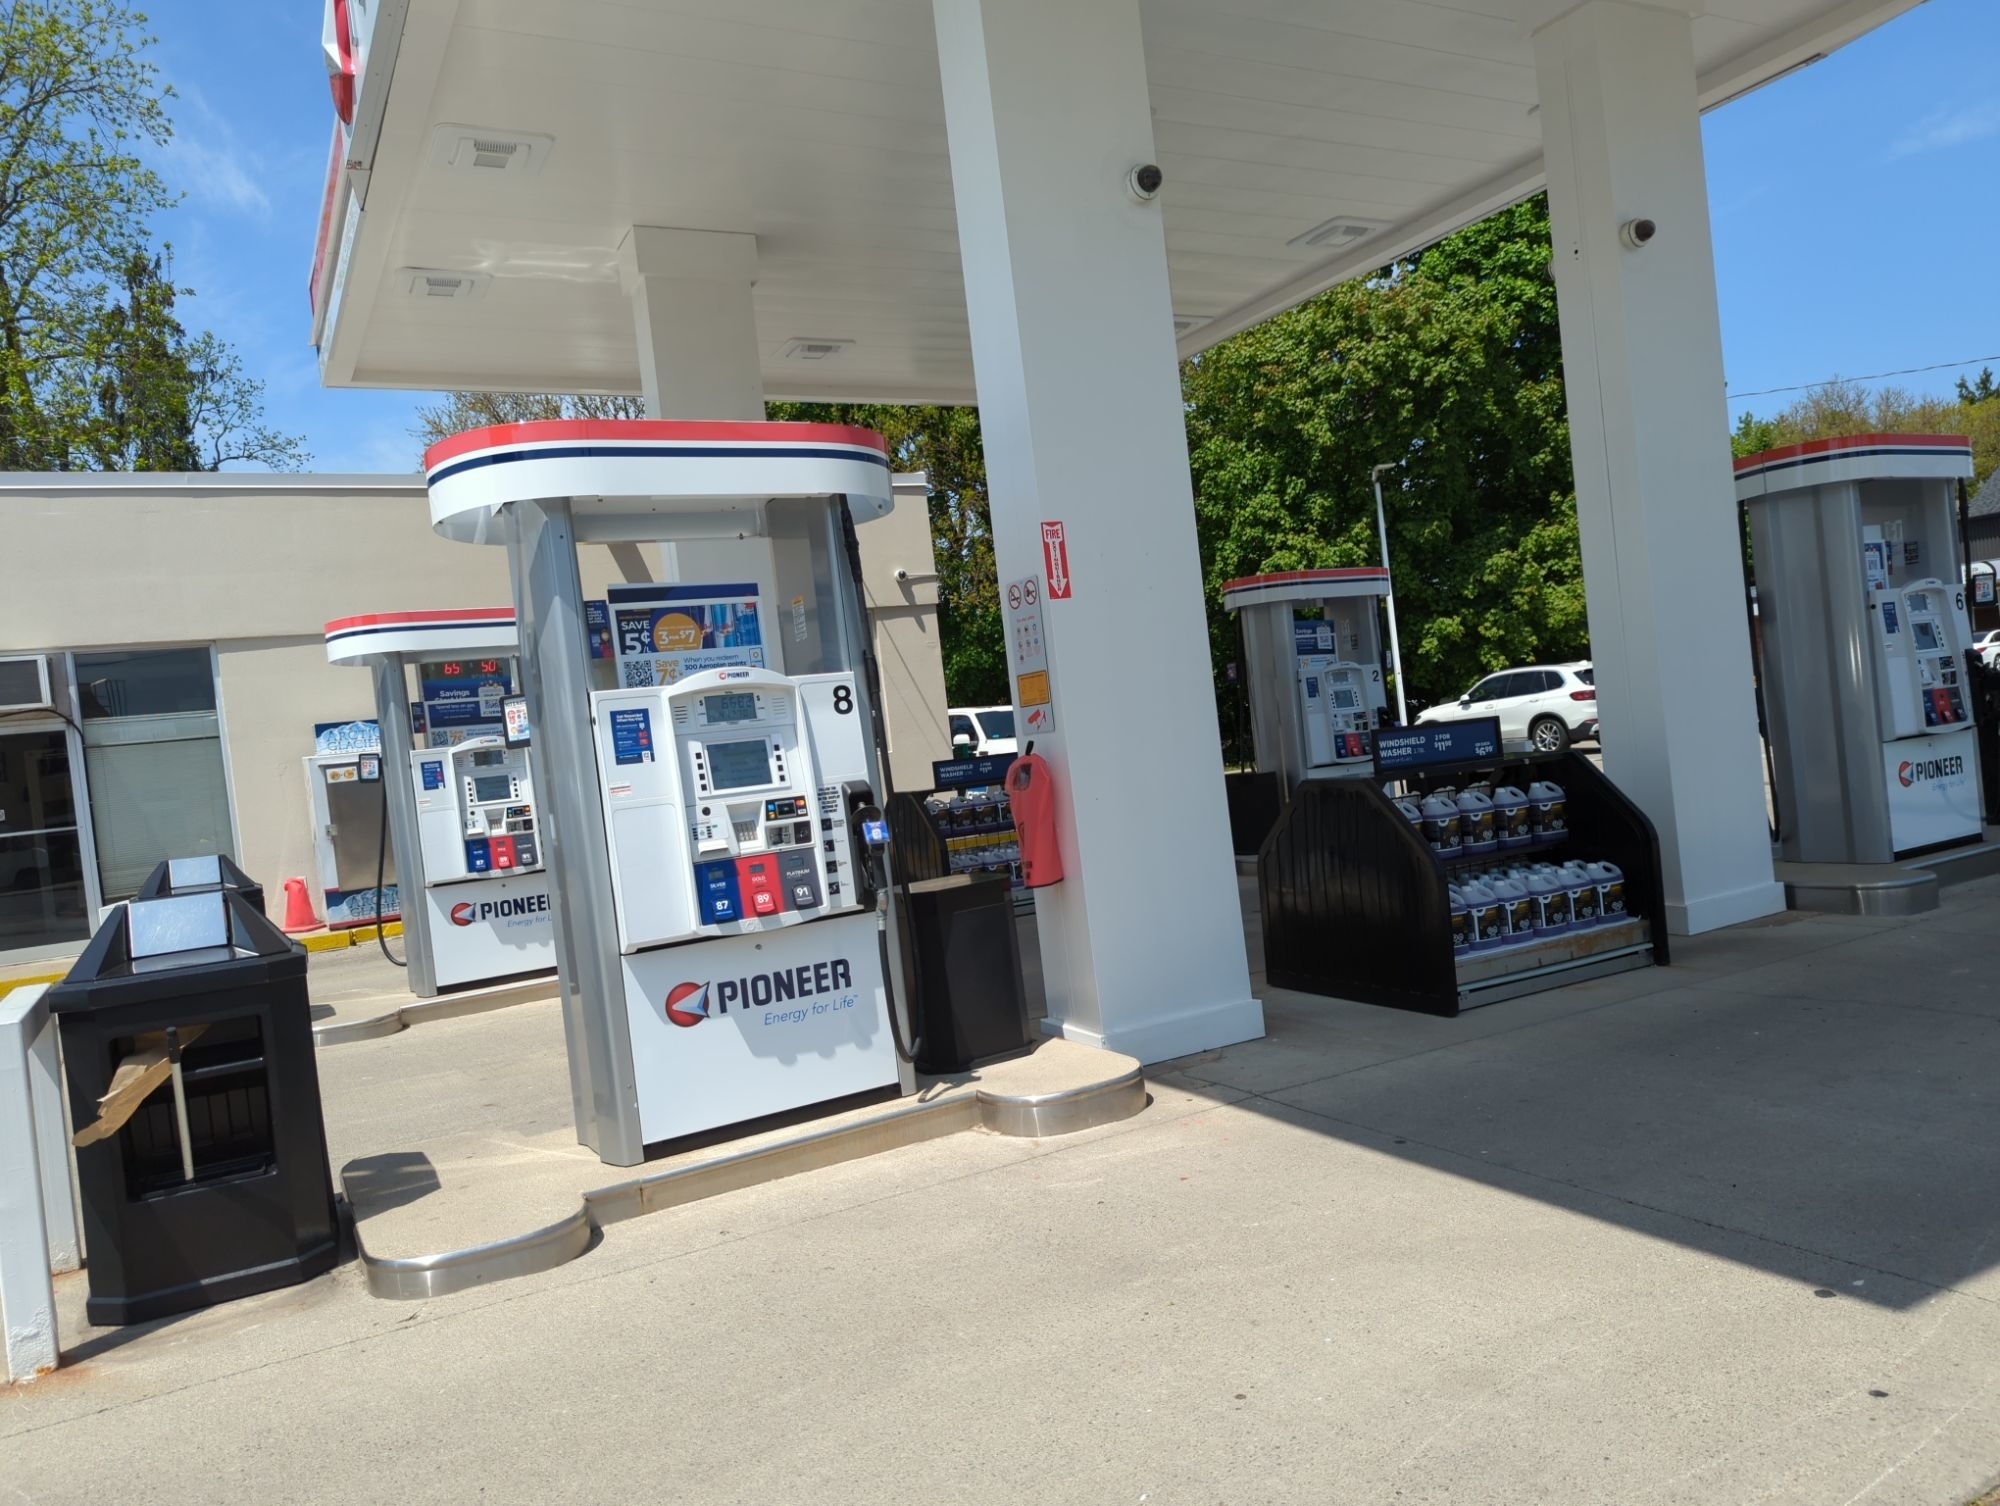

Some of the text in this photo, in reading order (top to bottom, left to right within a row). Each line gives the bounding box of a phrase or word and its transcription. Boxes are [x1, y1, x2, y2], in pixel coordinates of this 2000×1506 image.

[1045, 529, 1061, 539] FIRE
[1956, 593, 1964, 610] 6
[621, 620, 651, 631] SAVE
[658, 631, 669, 645] 3
[655, 658, 680, 668] Save
[683, 655, 703, 663] When
[703, 655, 715, 664] you
[444, 663, 460, 675] 65
[1372, 670, 1380, 682] 2
[439, 689, 470, 698] Savings
[833, 684, 853, 715] 8
[1379, 736, 1426, 749] WINDSHIELD
[1380, 746, 1412, 758] WASHER
[1916, 756, 1963, 781] PIONEER
[786, 868, 810, 877] PLATINUM
[710, 881, 726, 889] SILVER
[796, 887, 809, 896] 91
[716, 900, 729, 910] 87
[756, 894, 769, 904] 89
[480, 893, 551, 920] PIONEE
[717, 958, 853, 1014] PIONEER
[763, 1006, 809, 1026] Energy
[811, 1000, 829, 1015] for
